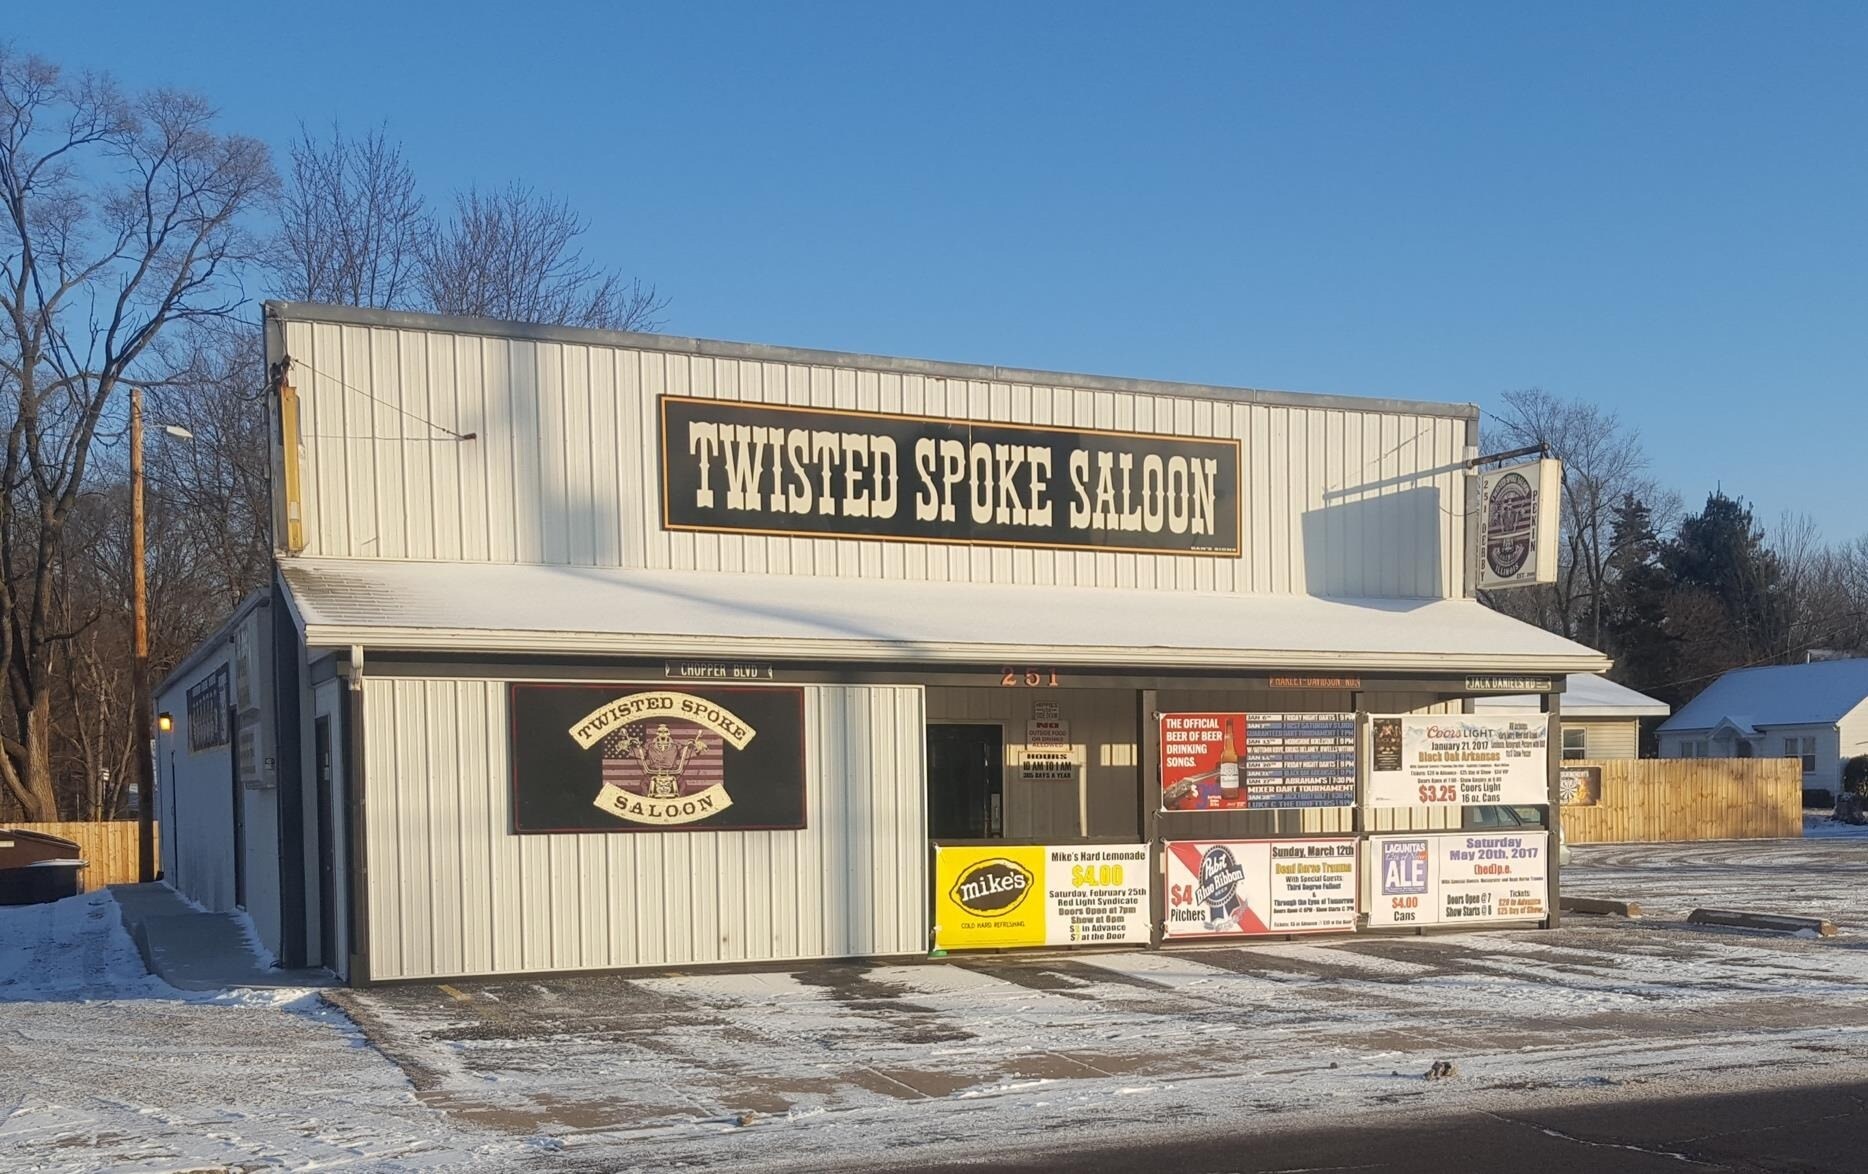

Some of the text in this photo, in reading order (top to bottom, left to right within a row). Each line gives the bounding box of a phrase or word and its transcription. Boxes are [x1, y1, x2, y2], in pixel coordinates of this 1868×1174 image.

[689, 421, 1218, 535] TWISTED SPOKE SALOON
[1495, 565, 1519, 577] ILLINOIS
[680, 664, 759, 678] CHOPPER BLVD
[1001, 666, 1059, 686] 251
[1469, 677, 1490, 689] JACK
[1492, 677, 1523, 689] DANIELS
[578, 697, 746, 741] TWISTED SPOKE
[1166, 718, 1219, 729] THE OFFICIAL
[1167, 731, 1222, 742] BEER OF BEER
[1427, 726, 1462, 739] Coors
[1463, 729, 1494, 738] LIGHT
[1167, 744, 1207, 754] DRINKING
[1431, 742, 1460, 751] January
[1472, 741, 1488, 750] 2017
[1167, 757, 1197, 767] SONGS.
[1419, 752, 1442, 762] Black
[1444, 752, 1460, 762] Oak
[1462, 751, 1501, 761] Arkansas
[1023, 761, 1031, 771] 10
[1032, 761, 1043, 771] AM
[1046, 761, 1054, 771] TO
[1061, 761, 1071, 771] AM
[1461, 783, 1501, 793] Coors Light
[1419, 784, 1457, 804] $3.25
[1462, 794, 1469, 803] 16
[1482, 793, 1500, 802] Cans
[614, 794, 714, 818] SALOON
[1384, 843, 1426, 854] LAGUNITAS
[1466, 837, 1522, 849] Saturday
[1051, 851, 1146, 862] Mike's Hard Lemonade
[1272, 845, 1354, 858] Sunday, March 12th
[1450, 848, 1538, 862] May 20th, 2017
[1203, 853, 1227, 880] Pabst
[1071, 864, 1124, 887] $4.00
[1385, 860, 1425, 888] ALE
[960, 871, 1026, 902] mike's
[1196, 869, 1243, 904] Blue Ribbon
[1089, 889, 1126, 898] February
[1128, 888, 1147, 896] 25th
[1171, 884, 1192, 907] $4
[1057, 898, 1138, 907] Red Light Syndicate
[1392, 897, 1418, 909] $4.00
[1447, 893, 1491, 905] Doors Open @ 7
[1058, 908, 1085, 916] Doors
[1086, 907, 1108, 916] Open
[1119, 906, 1136, 915] 7pm
[1171, 909, 1205, 922] Pitchers
[1394, 910, 1416, 921] Cans
[1446, 907, 1462, 917] Show
[1463, 906, 1480, 916] Starts
[1509, 907, 1519, 915] Day
[977, 921, 993, 929] HARD
[1071, 916, 1095, 924] Show
[1082, 924, 1090, 932] in
[1092, 924, 1126, 932] Advance
[1081, 933, 1089, 941] at
[1106, 932, 1125, 940] Door
